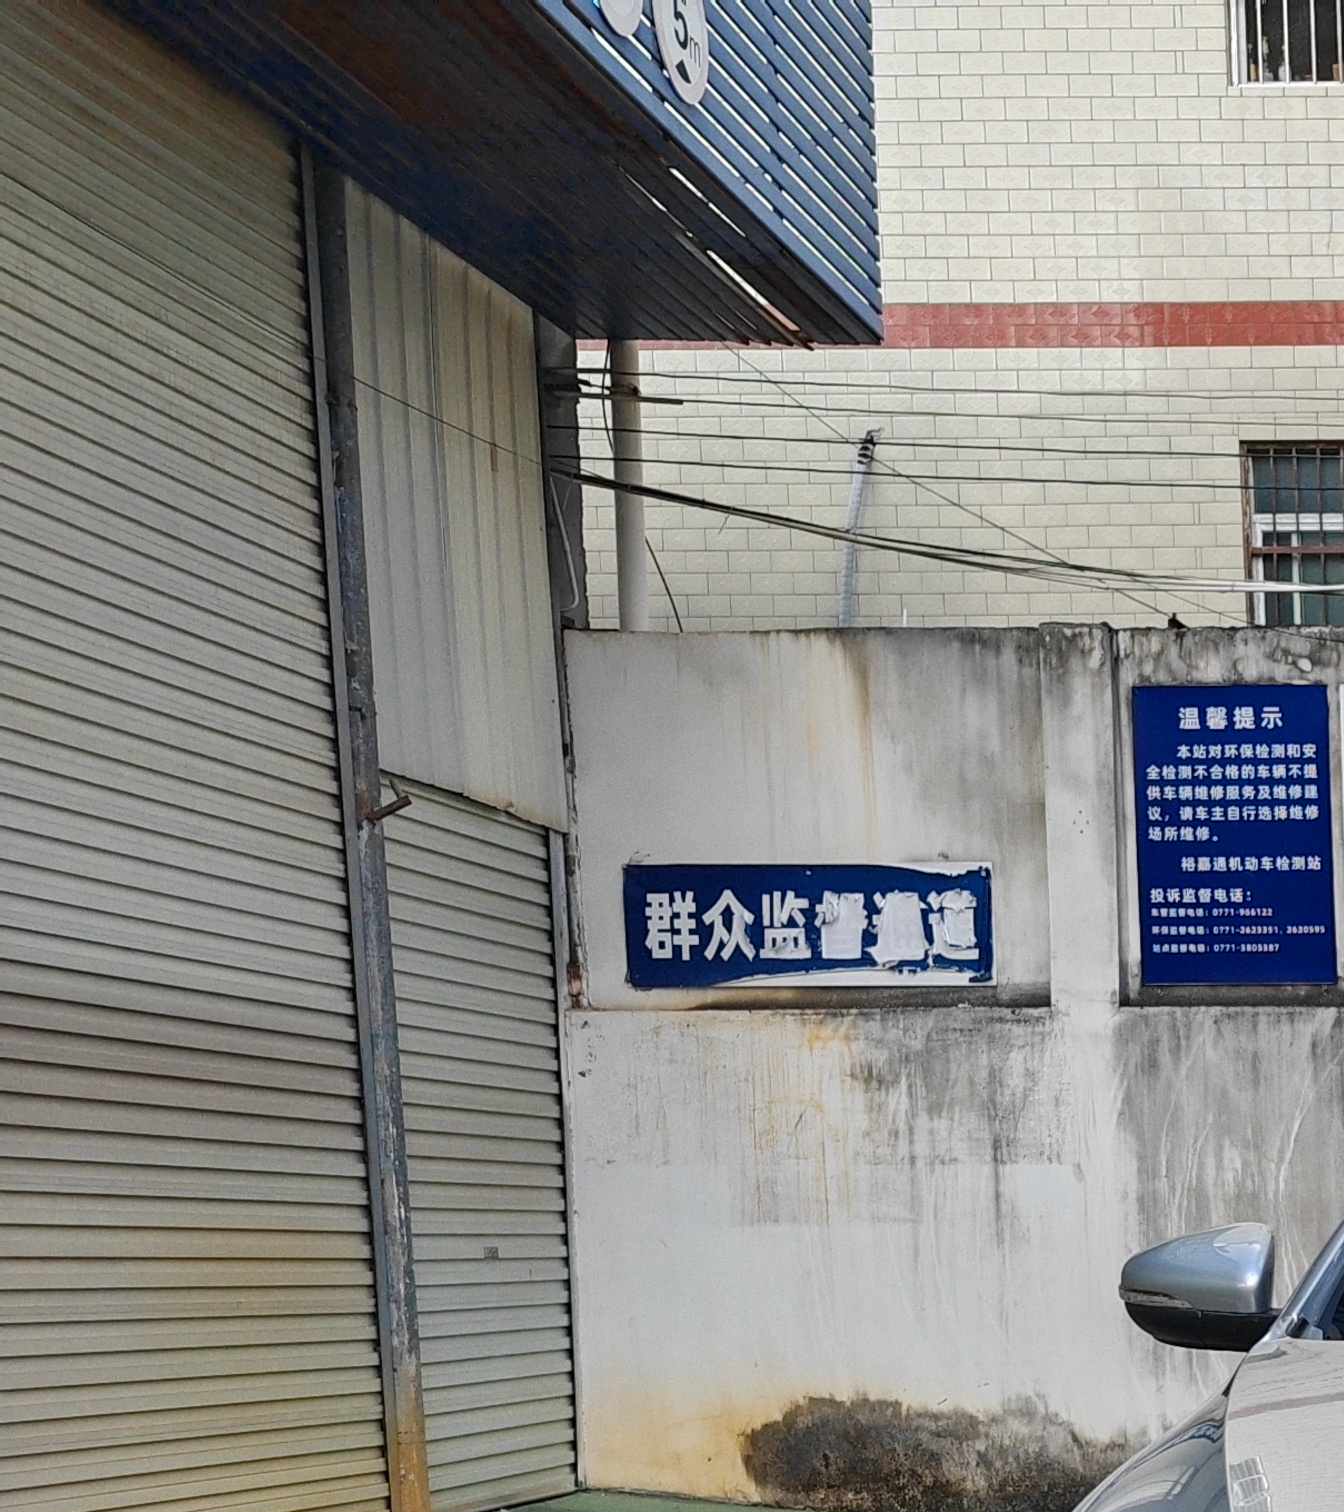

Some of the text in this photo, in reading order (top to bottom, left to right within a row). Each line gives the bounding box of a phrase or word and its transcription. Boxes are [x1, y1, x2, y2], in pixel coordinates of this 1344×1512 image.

[1178, 706, 1283, 730] 温馨提示
[1176, 743, 1317, 760] 本站对环保检测和安
[1146, 763, 1318, 780] 全检测不合格的车辆不提
[1146, 784, 1318, 801] 供车辆维修服务及维修建
[1148, 826, 1219, 842] 场所维修。
[1150, 887, 1252, 904] 投诉监督电话：
[645, 888, 980, 968] 群众监督道
